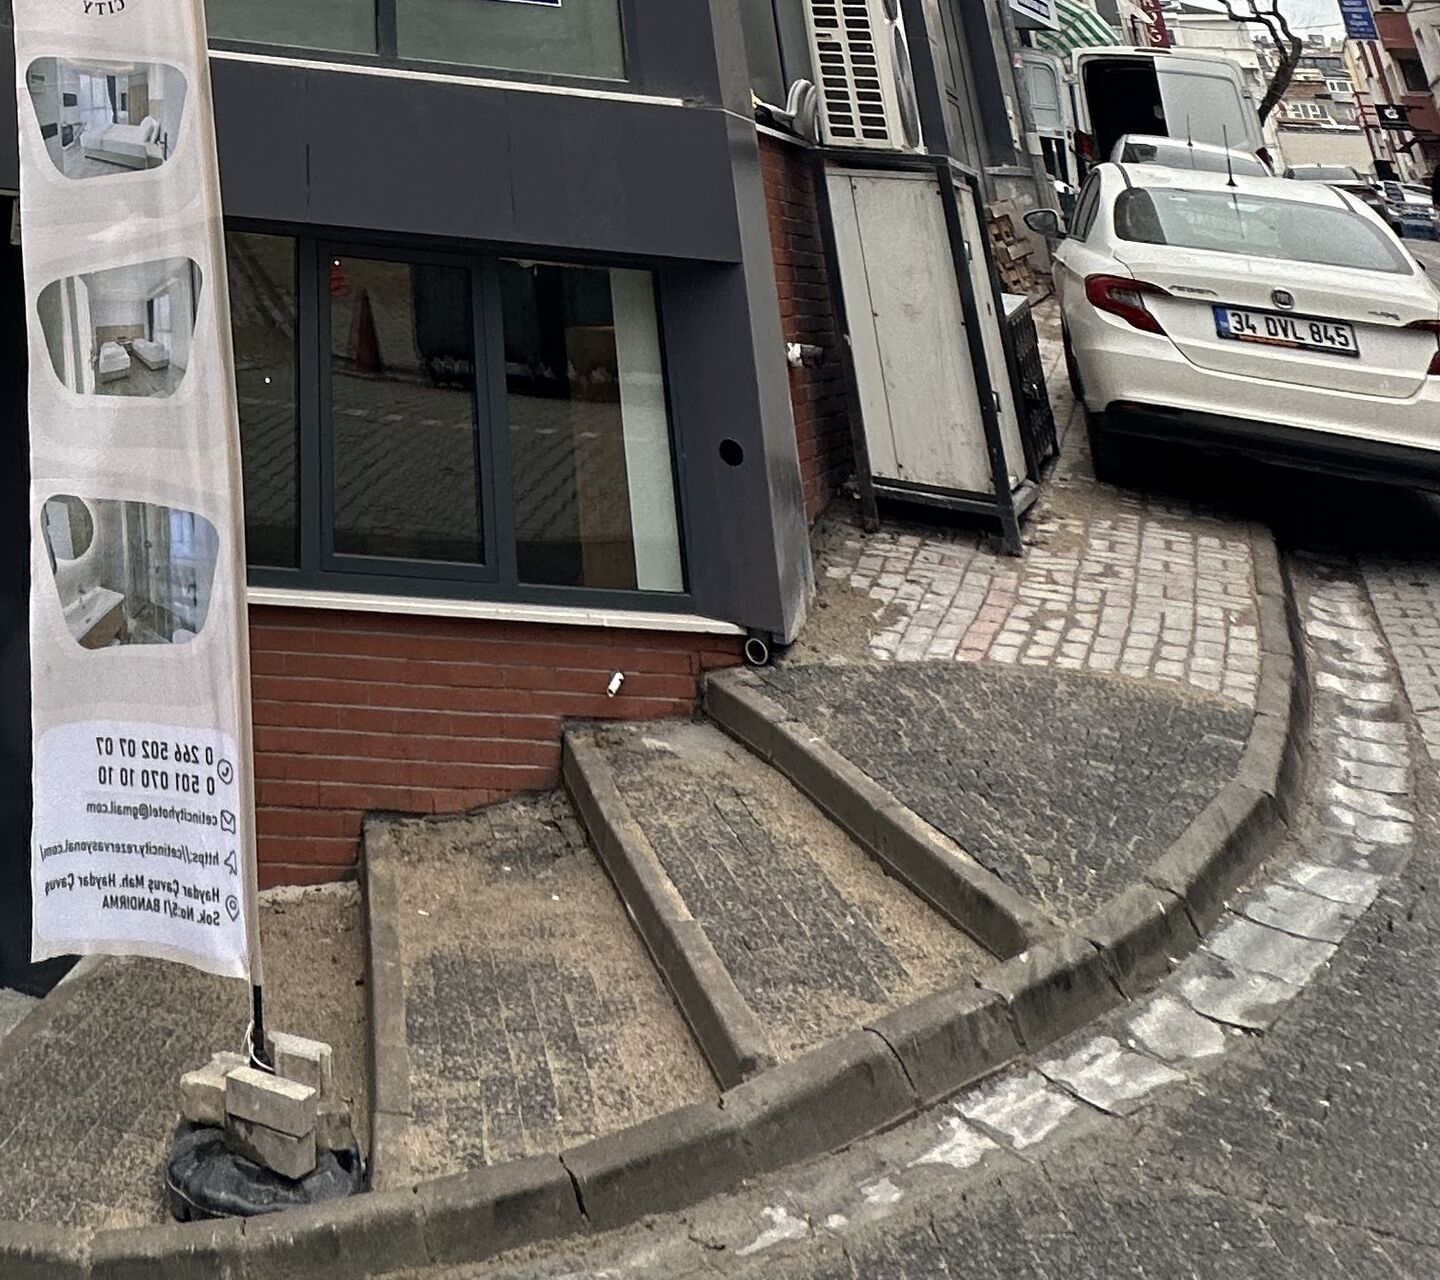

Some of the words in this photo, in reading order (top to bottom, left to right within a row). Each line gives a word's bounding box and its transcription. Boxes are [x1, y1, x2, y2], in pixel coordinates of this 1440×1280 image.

[1231, 311, 1257, 334] 34
[1265, 316, 1305, 342] DVL
[1310, 322, 1351, 348] 845
